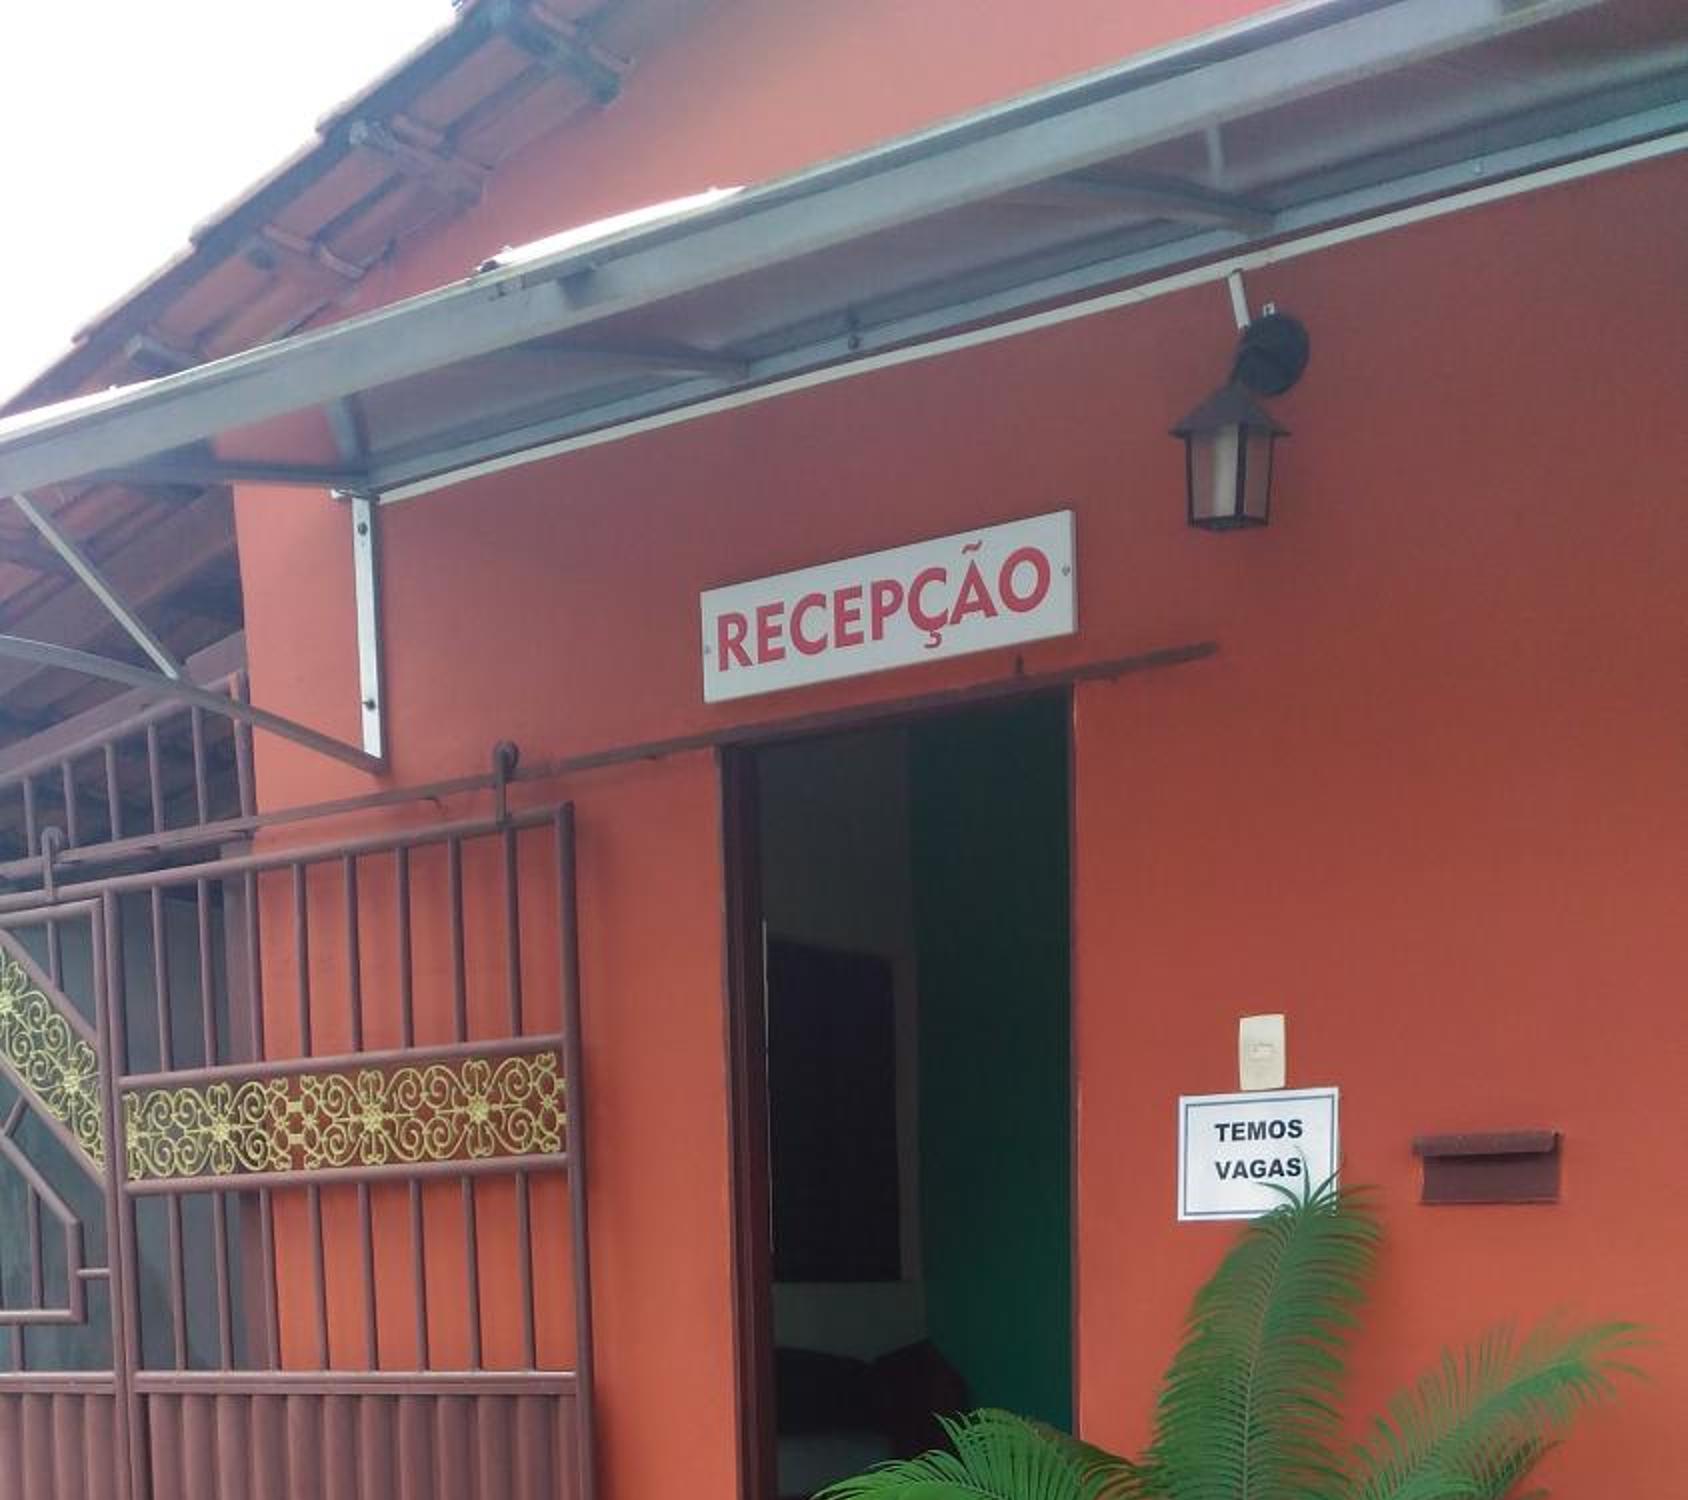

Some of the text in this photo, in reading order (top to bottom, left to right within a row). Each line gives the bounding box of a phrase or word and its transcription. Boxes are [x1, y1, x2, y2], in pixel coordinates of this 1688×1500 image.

[717, 540, 1051, 672] RECEPÇÃO
[1214, 1119, 1303, 1142] TEMOS
[1215, 1157, 1302, 1180] VAGAS
